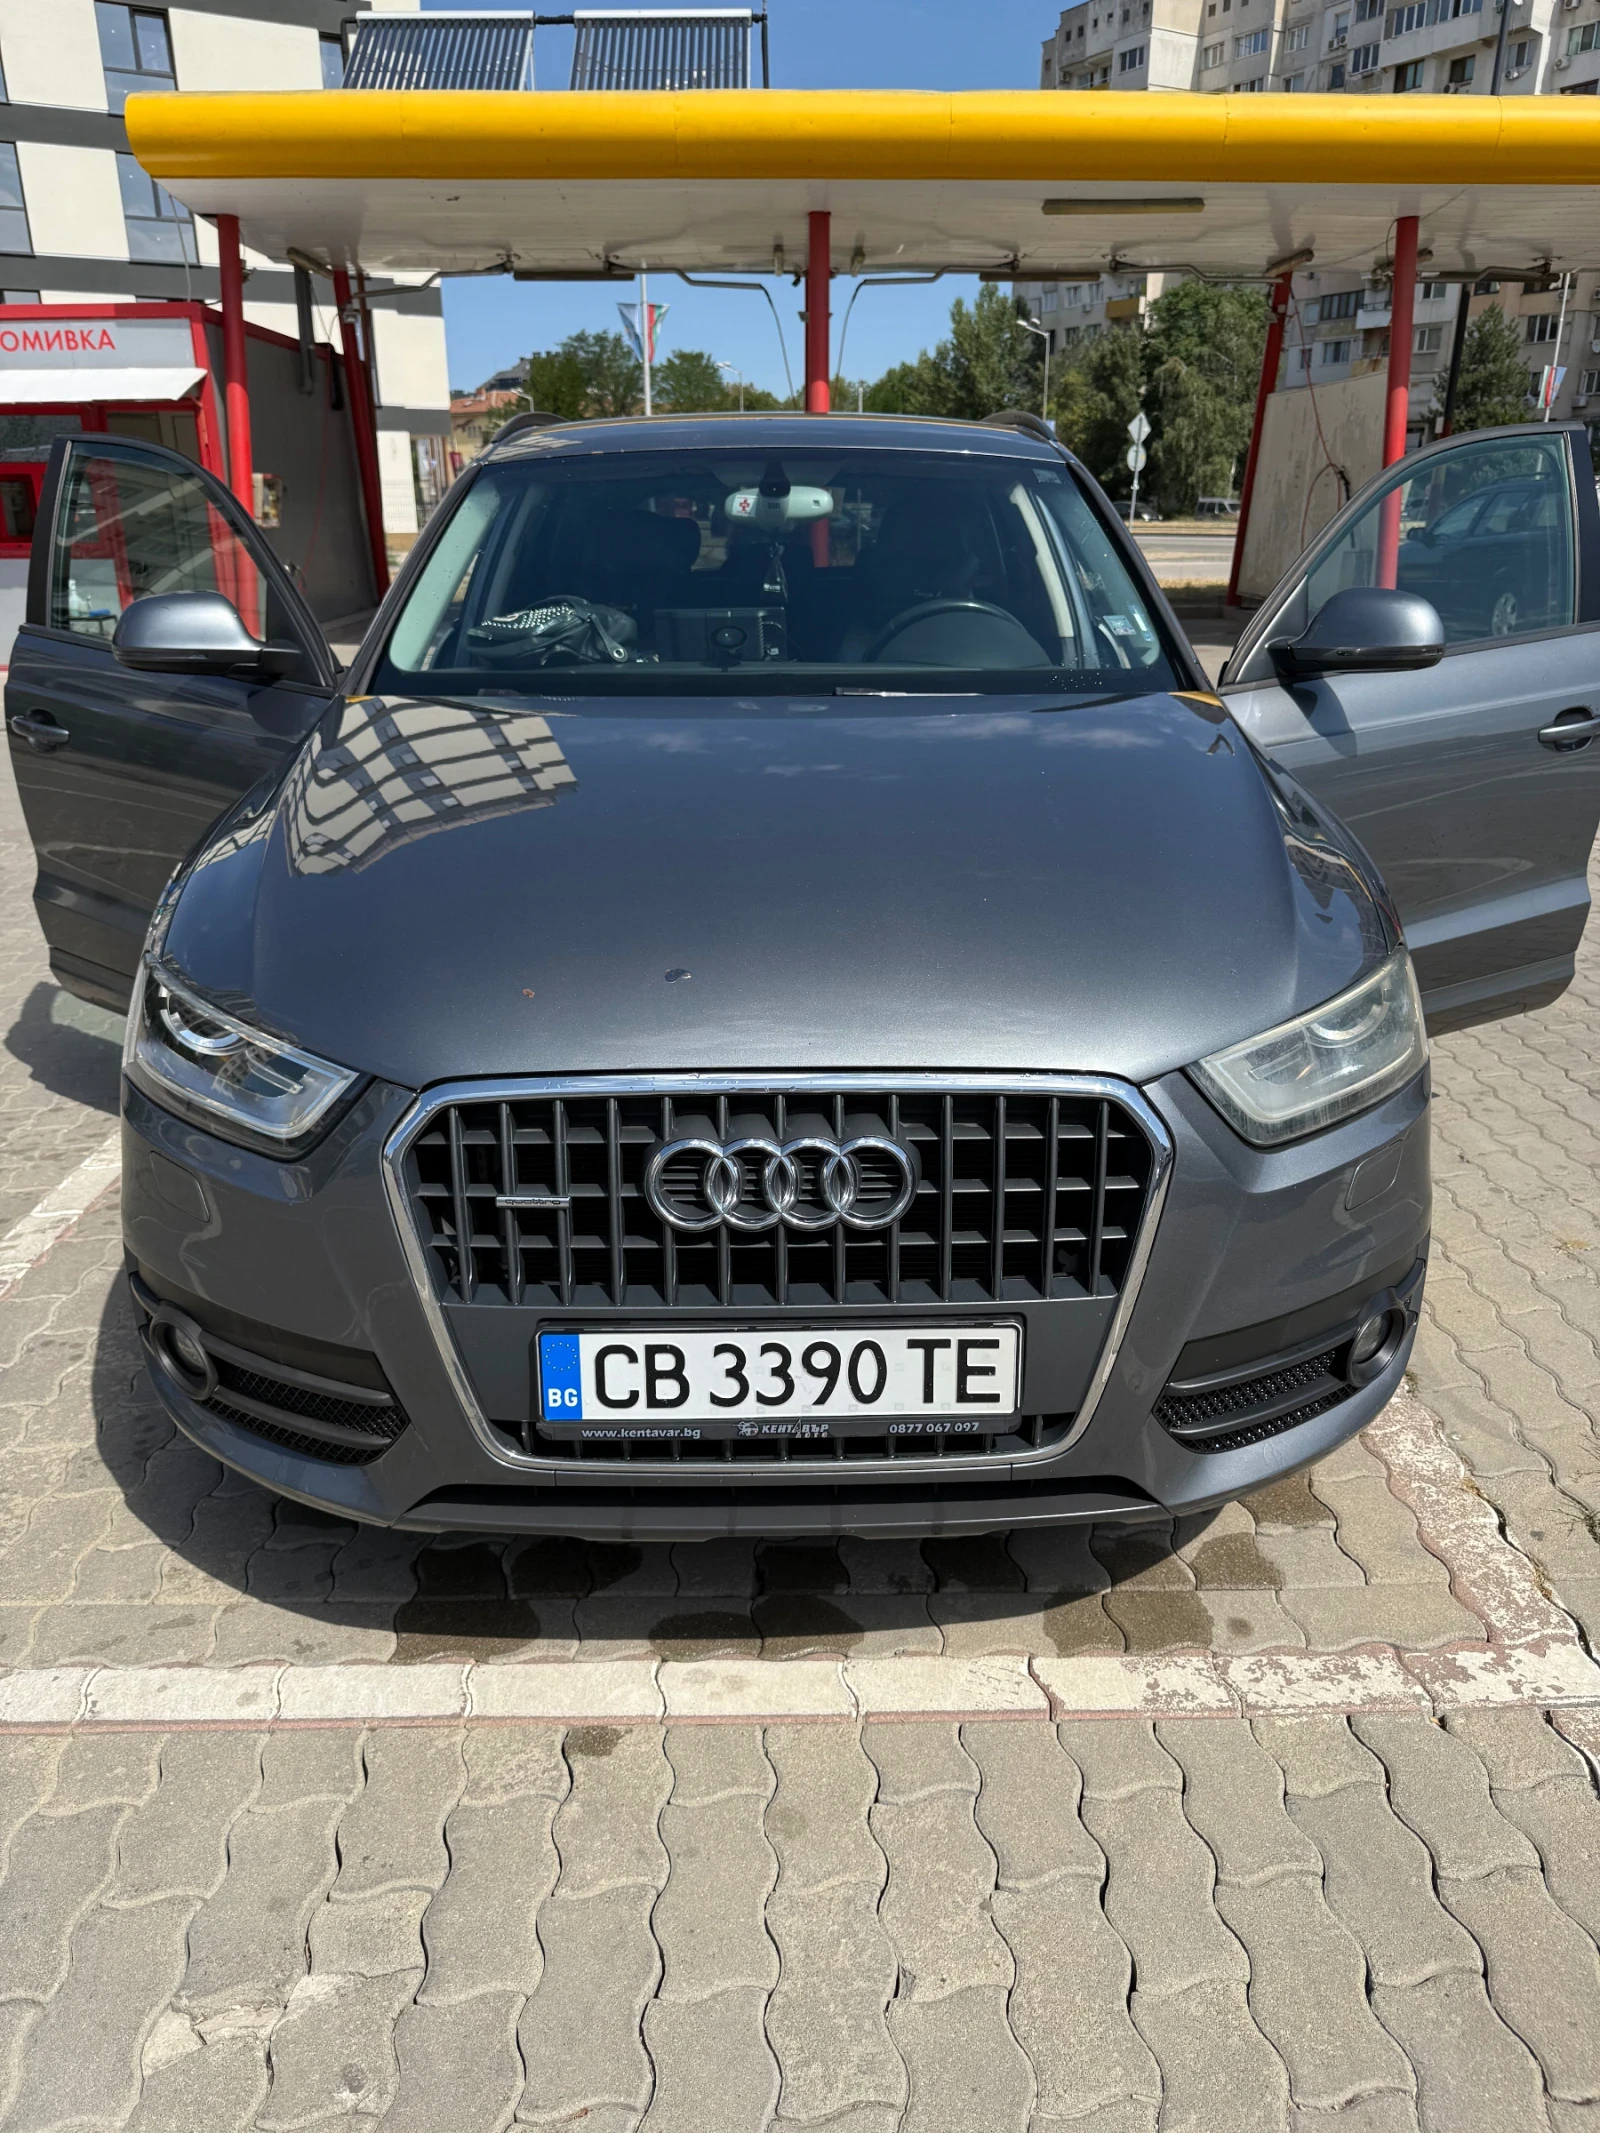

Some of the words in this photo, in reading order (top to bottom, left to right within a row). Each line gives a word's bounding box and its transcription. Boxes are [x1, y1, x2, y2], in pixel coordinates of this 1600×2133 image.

[0, 328, 116, 352] ОМИВКА
[595, 1344, 690, 1408] CB
[710, 1339, 887, 1407] 3390
[907, 1338, 1000, 1403] TE
[548, 1388, 578, 1407] BG
[581, 1428, 701, 1439] www.kentavar.bg
[889, 1424, 922, 1433] 0877
[926, 1423, 951, 1433] 067
[955, 1422, 979, 1432] 097
